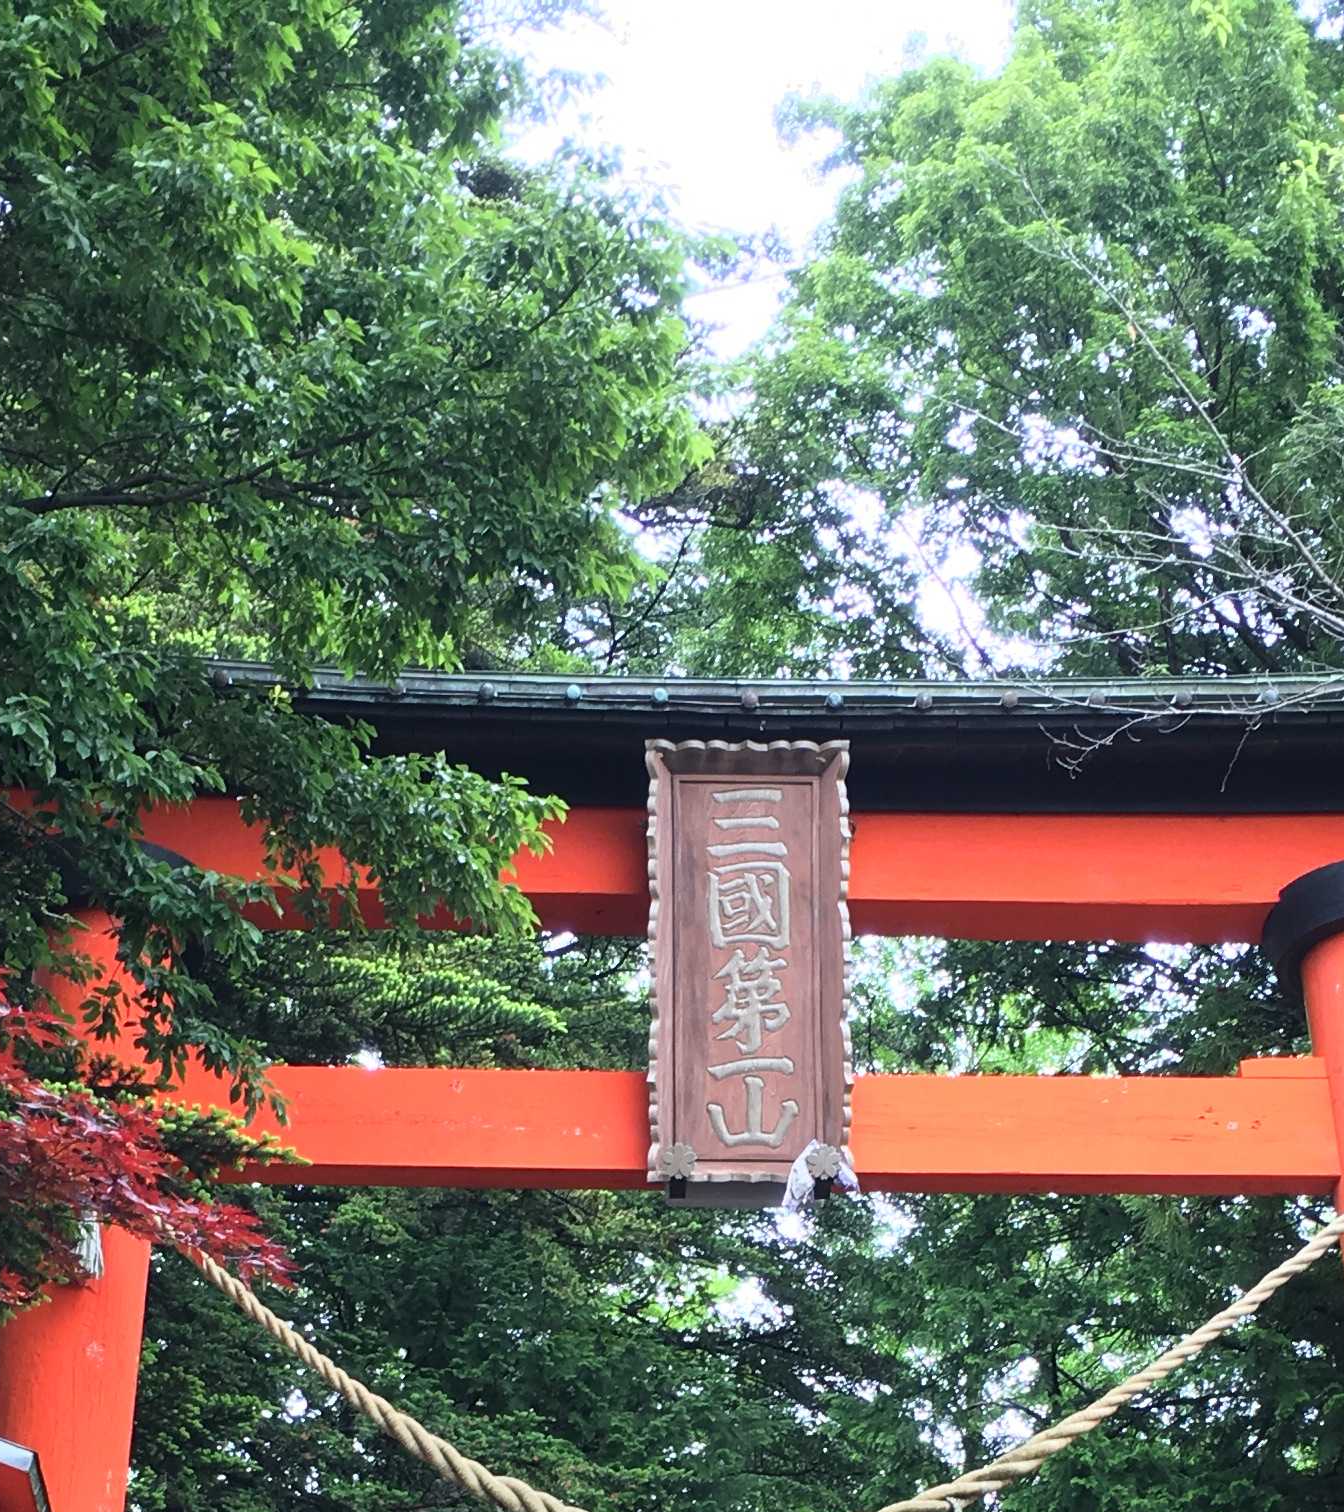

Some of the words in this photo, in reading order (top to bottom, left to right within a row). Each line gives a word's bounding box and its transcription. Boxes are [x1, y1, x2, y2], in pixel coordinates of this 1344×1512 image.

[705, 787, 801, 1149] 三國第一山
